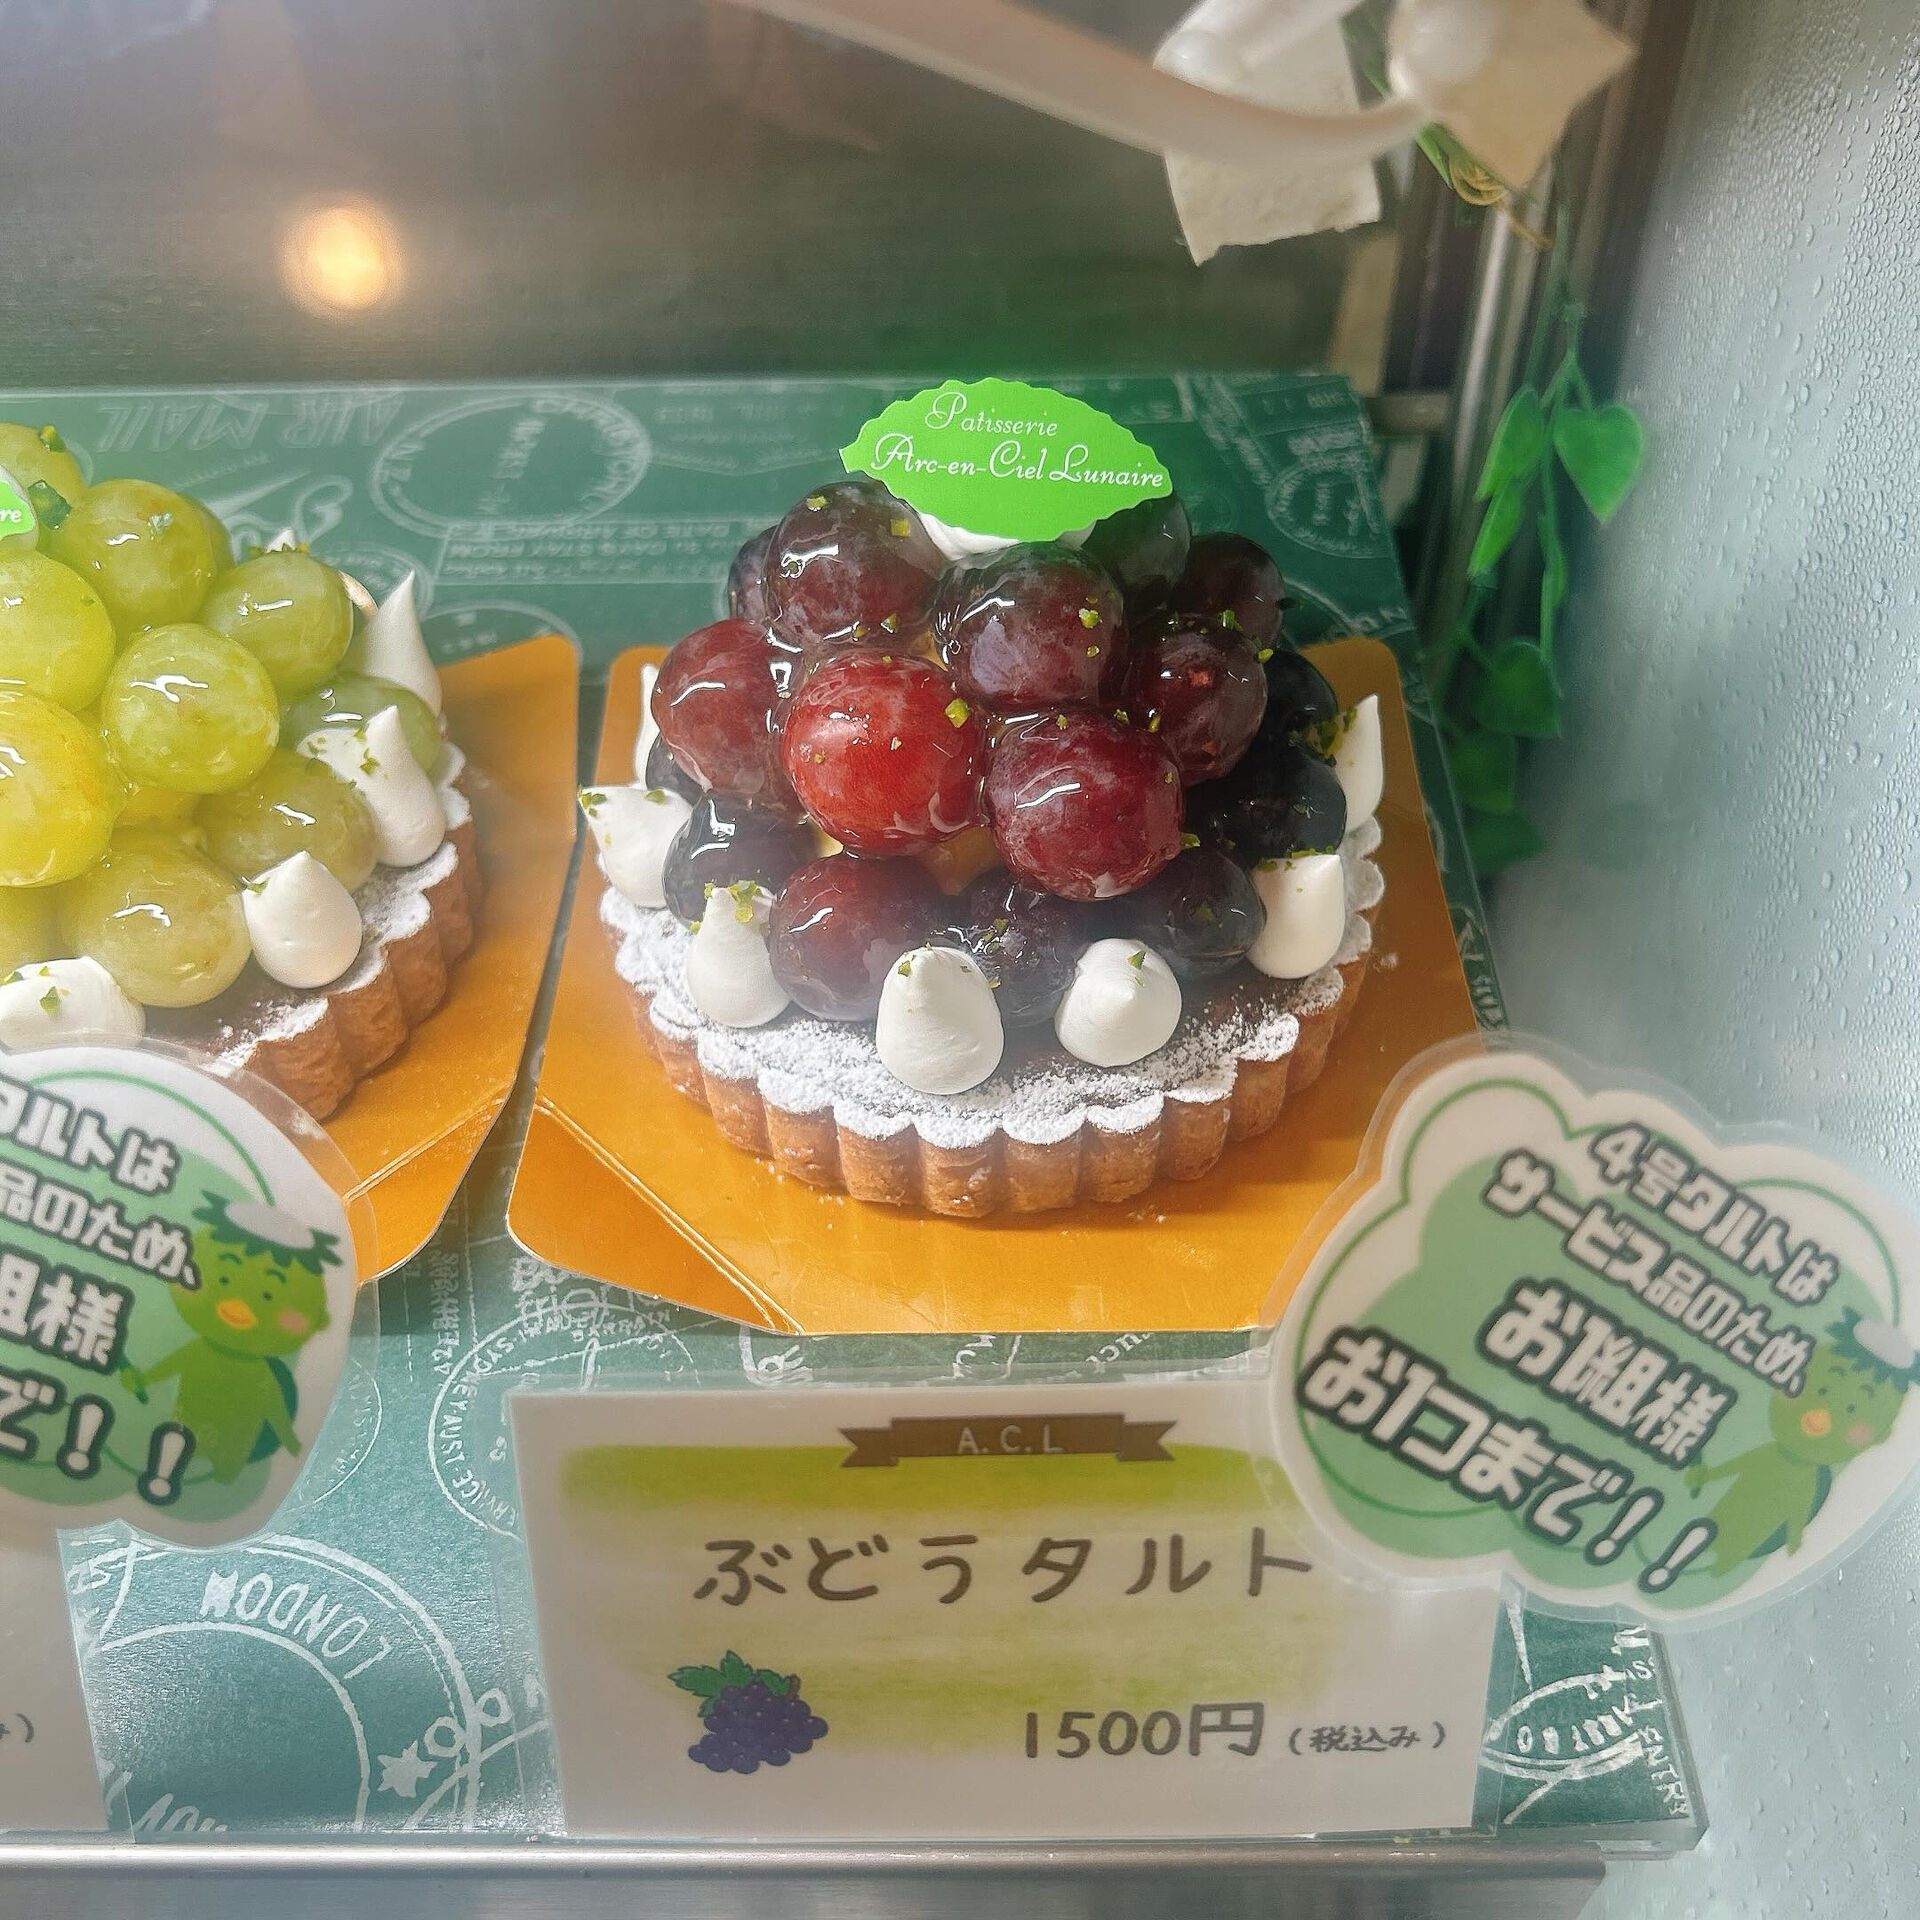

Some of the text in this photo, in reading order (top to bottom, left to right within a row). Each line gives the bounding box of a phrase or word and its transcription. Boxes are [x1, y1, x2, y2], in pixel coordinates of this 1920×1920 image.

[97, 400, 270, 451] MAIL
[925, 392, 1058, 436] Patisserie
[871, 432, 1163, 487] Arc-en-Ciel Lunaire
[1590, 1122, 1839, 1305] 4号タルトは
[1482, 1148, 1816, 1396] サービス品のため、
[694, 1527, 1312, 1606] ぶどうタルト
[1024, 1702, 1265, 1759] 1500円
